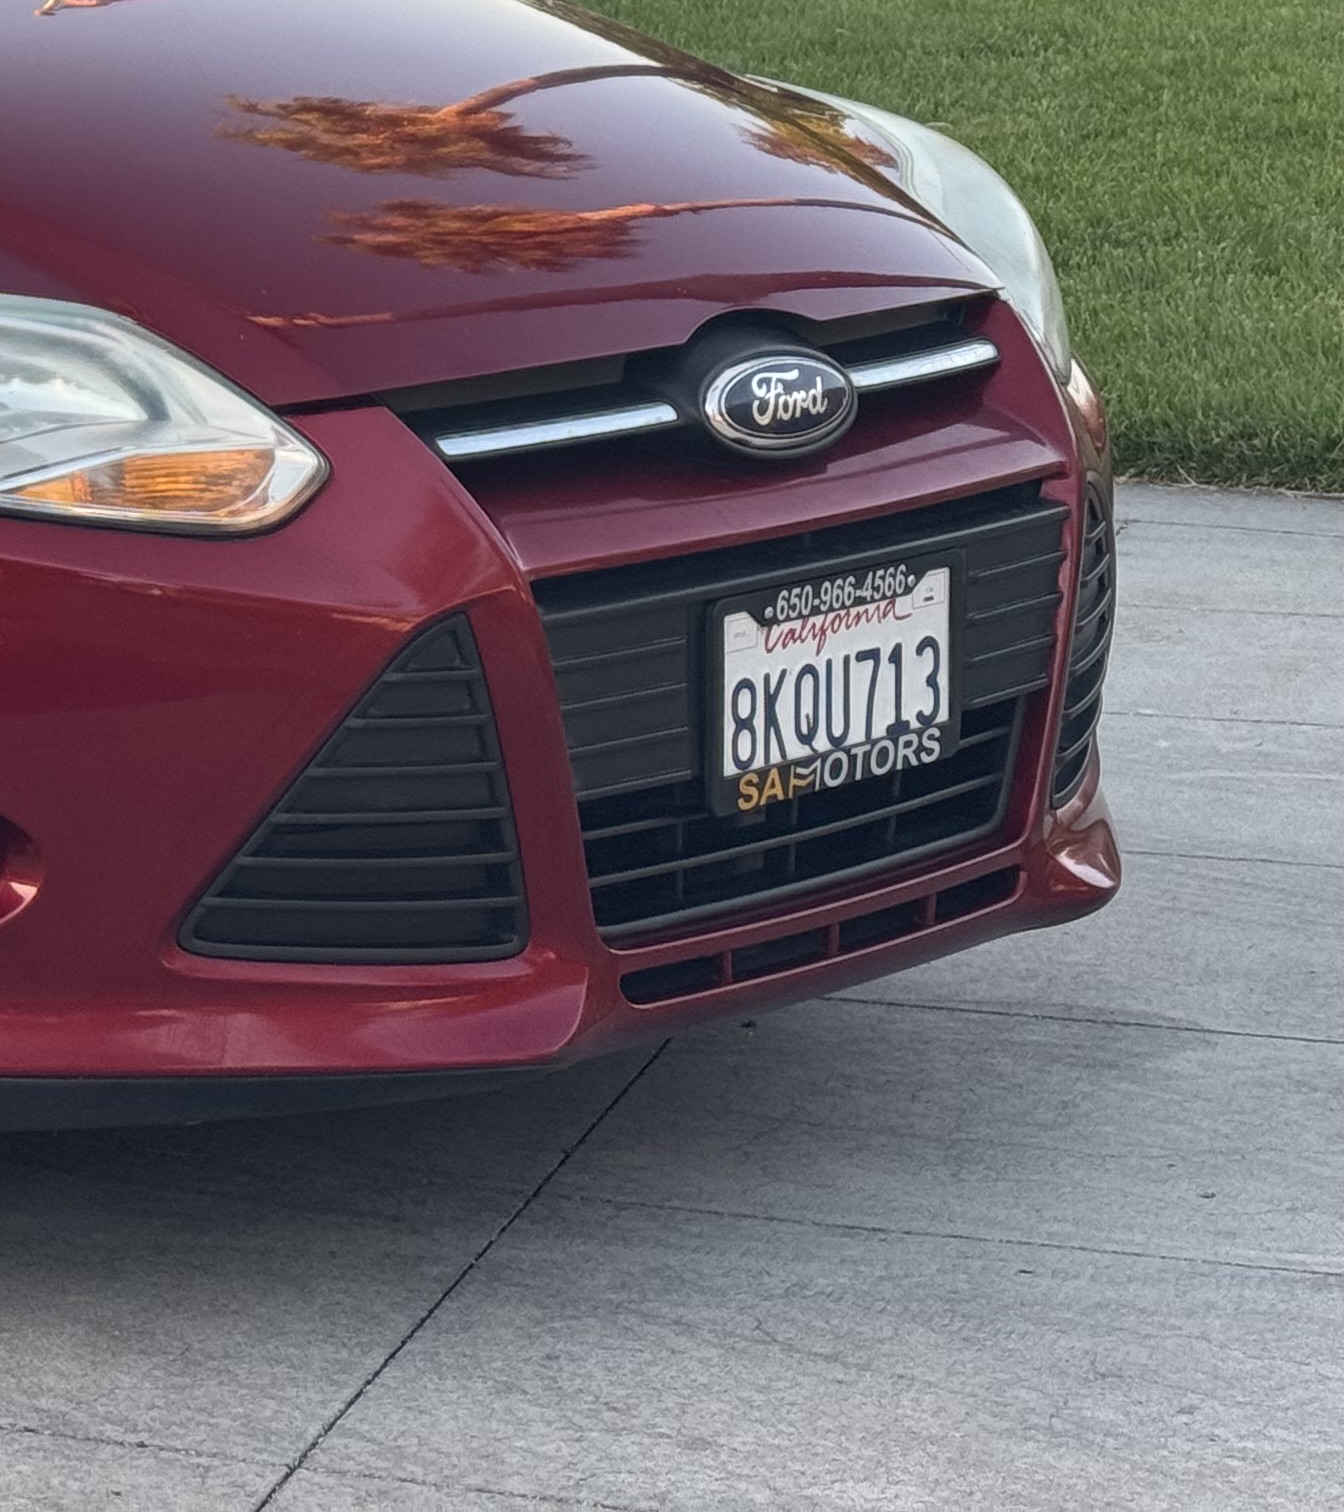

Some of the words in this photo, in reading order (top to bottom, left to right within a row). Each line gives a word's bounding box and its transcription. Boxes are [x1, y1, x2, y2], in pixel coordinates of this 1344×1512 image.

[751, 368, 829, 426] Ford
[775, 563, 907, 621] 650-966-4566
[763, 598, 913, 657] California
[731, 634, 941, 772] 8KQU713
